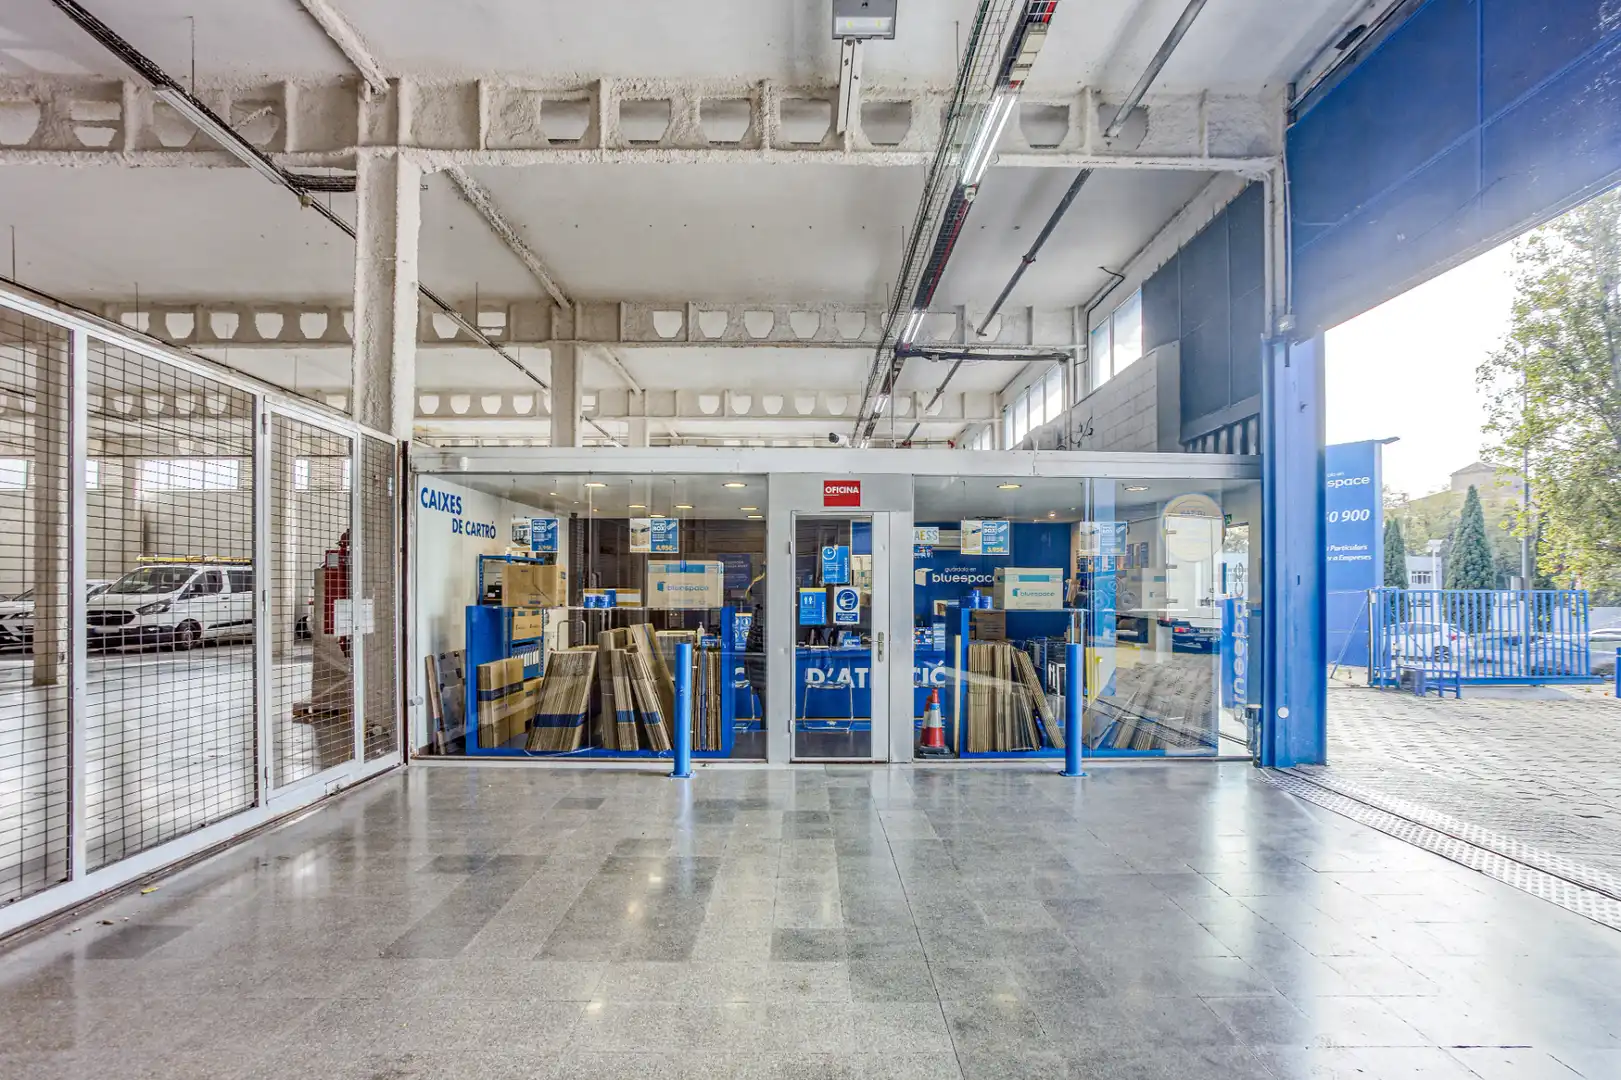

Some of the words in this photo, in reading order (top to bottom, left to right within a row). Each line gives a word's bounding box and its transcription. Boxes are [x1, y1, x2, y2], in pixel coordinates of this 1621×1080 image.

[1327, 476, 1370, 489] space
[824, 486, 860, 494] OFICINA
[420, 487, 462, 515] CAIXES
[1341, 508, 1370, 522] 900
[452, 518, 463, 534] DE
[465, 520, 496, 539] CARTRÓ
[1330, 543, 1368, 552] Particulars
[932, 573, 995, 585] bluespac
